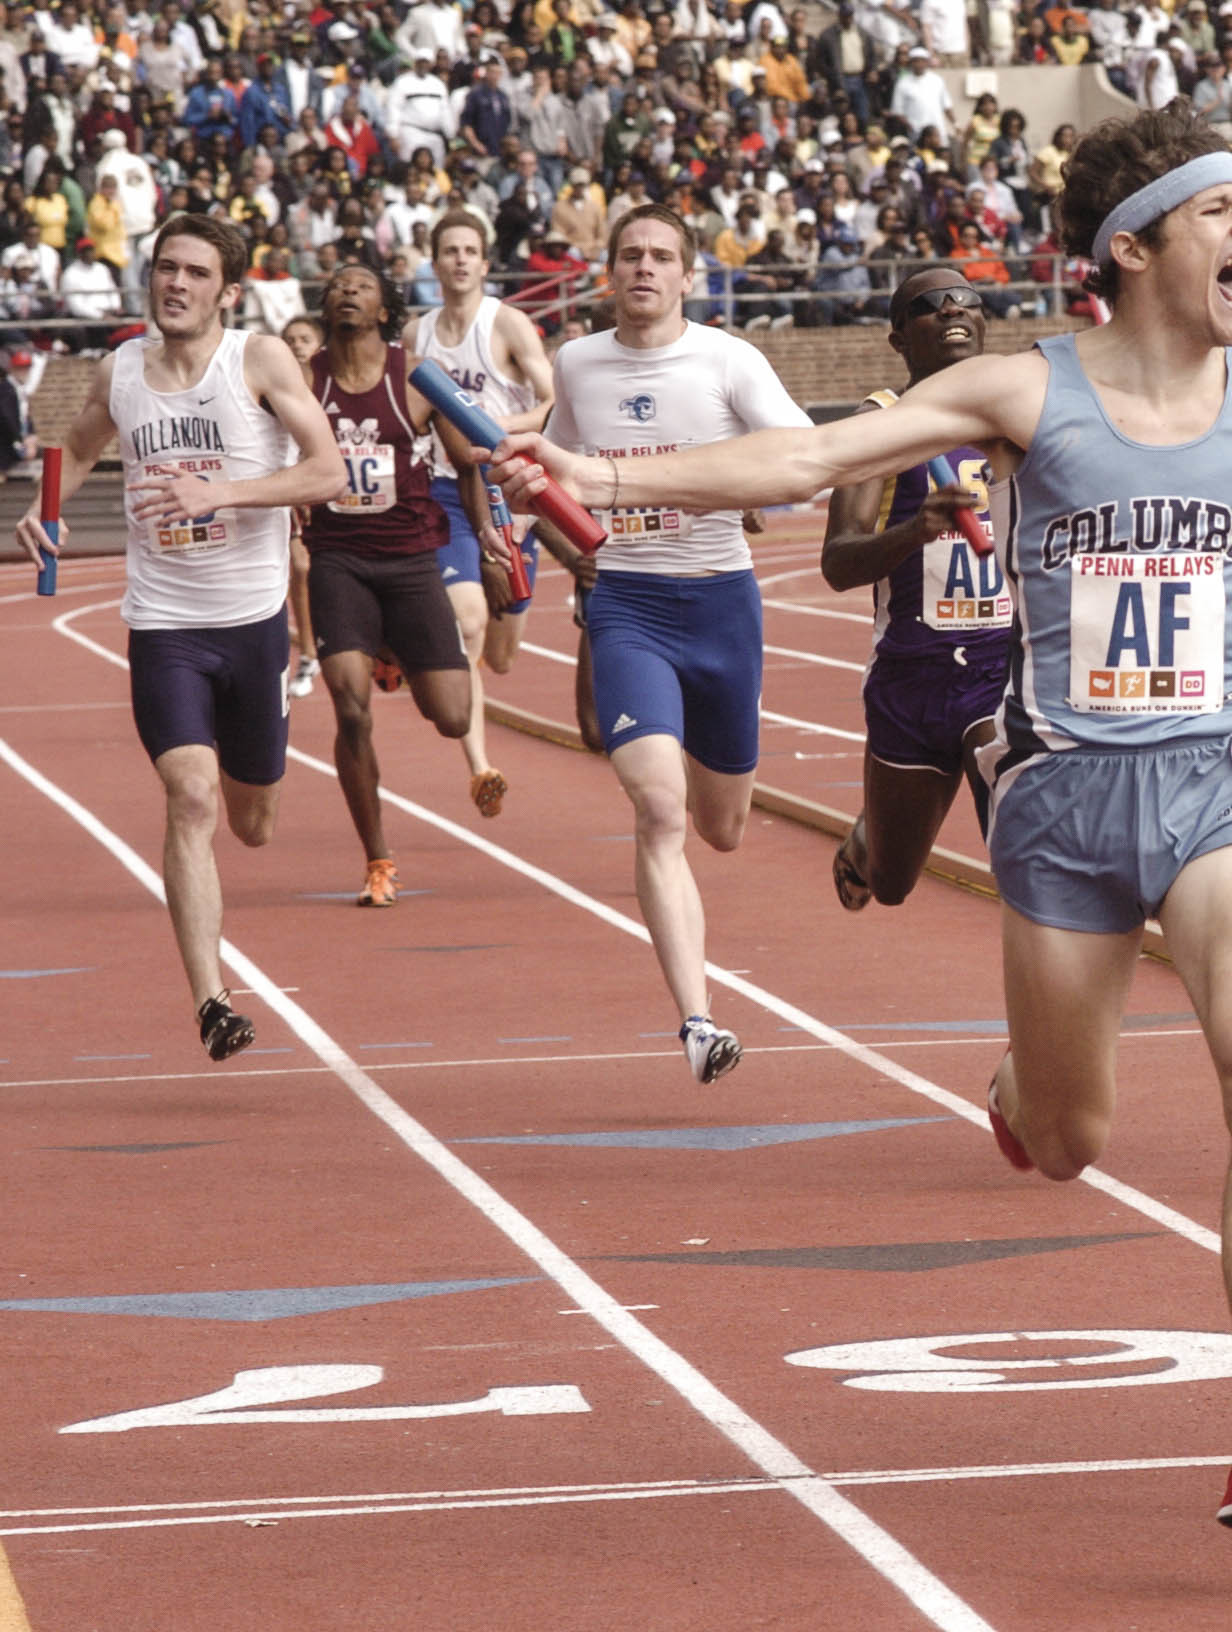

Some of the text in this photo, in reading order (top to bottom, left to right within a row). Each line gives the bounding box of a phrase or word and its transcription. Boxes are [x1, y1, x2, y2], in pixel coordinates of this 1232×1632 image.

[131, 416, 225, 461] VILLANOVA
[178, 459, 222, 473] RELAYS
[944, 543, 1004, 598] AD
[1080, 555, 1214, 577] PENN RELAYS
[1105, 582, 1191, 667] AF
[57, 1363, 592, 1435] 7
